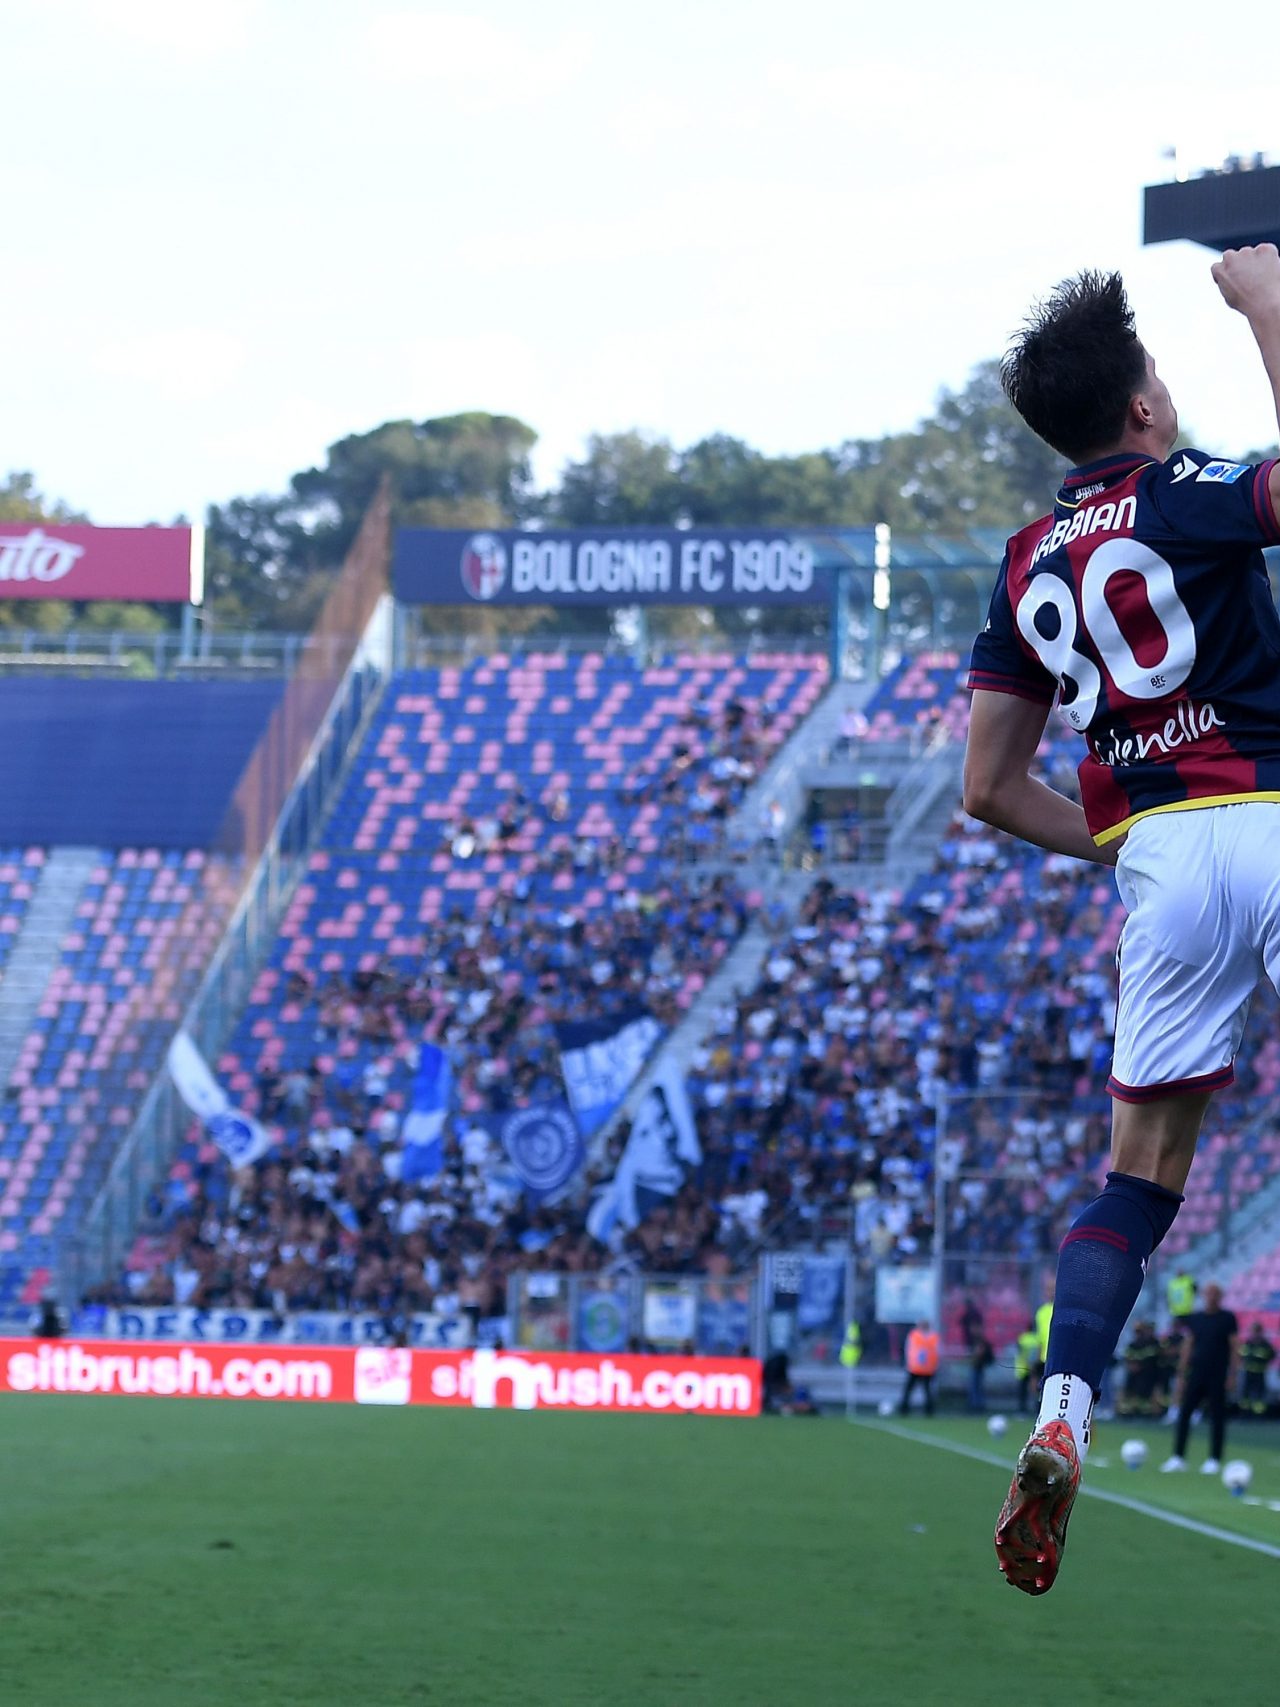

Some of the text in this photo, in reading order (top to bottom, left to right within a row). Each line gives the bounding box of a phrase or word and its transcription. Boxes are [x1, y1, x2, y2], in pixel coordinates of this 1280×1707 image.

[512, 540, 814, 592] BOLOGNA FC 1909
[1016, 537, 1196, 731] 80
[7, 1345, 332, 1398] sitbrush.com
